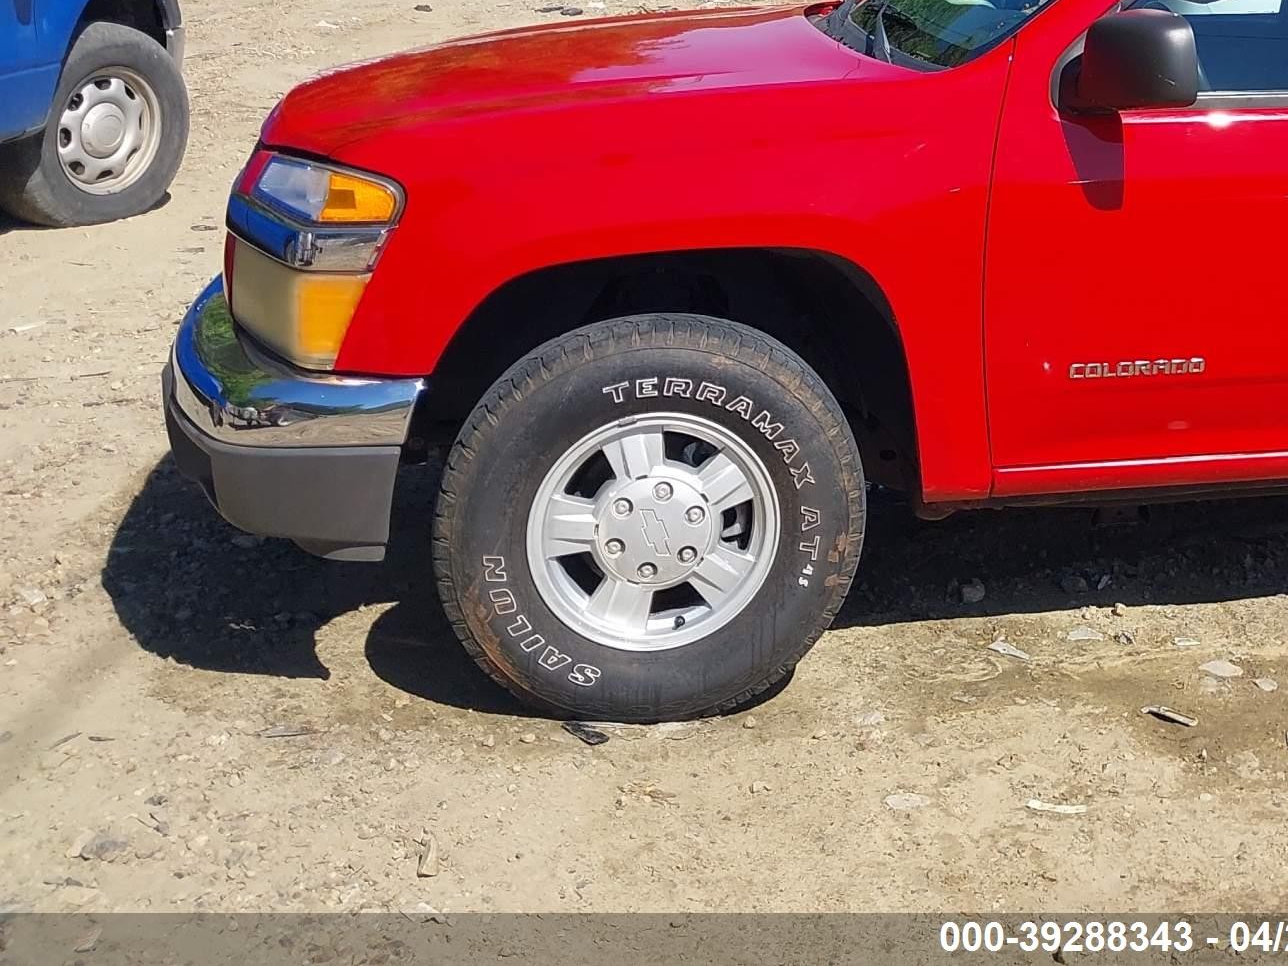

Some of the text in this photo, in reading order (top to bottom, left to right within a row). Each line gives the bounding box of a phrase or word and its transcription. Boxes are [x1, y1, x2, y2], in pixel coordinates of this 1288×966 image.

[1069, 357, 1206, 379] COLORADO
[602, 376, 816, 490] TERRAMAX
[482, 555, 601, 687] SAILUN
